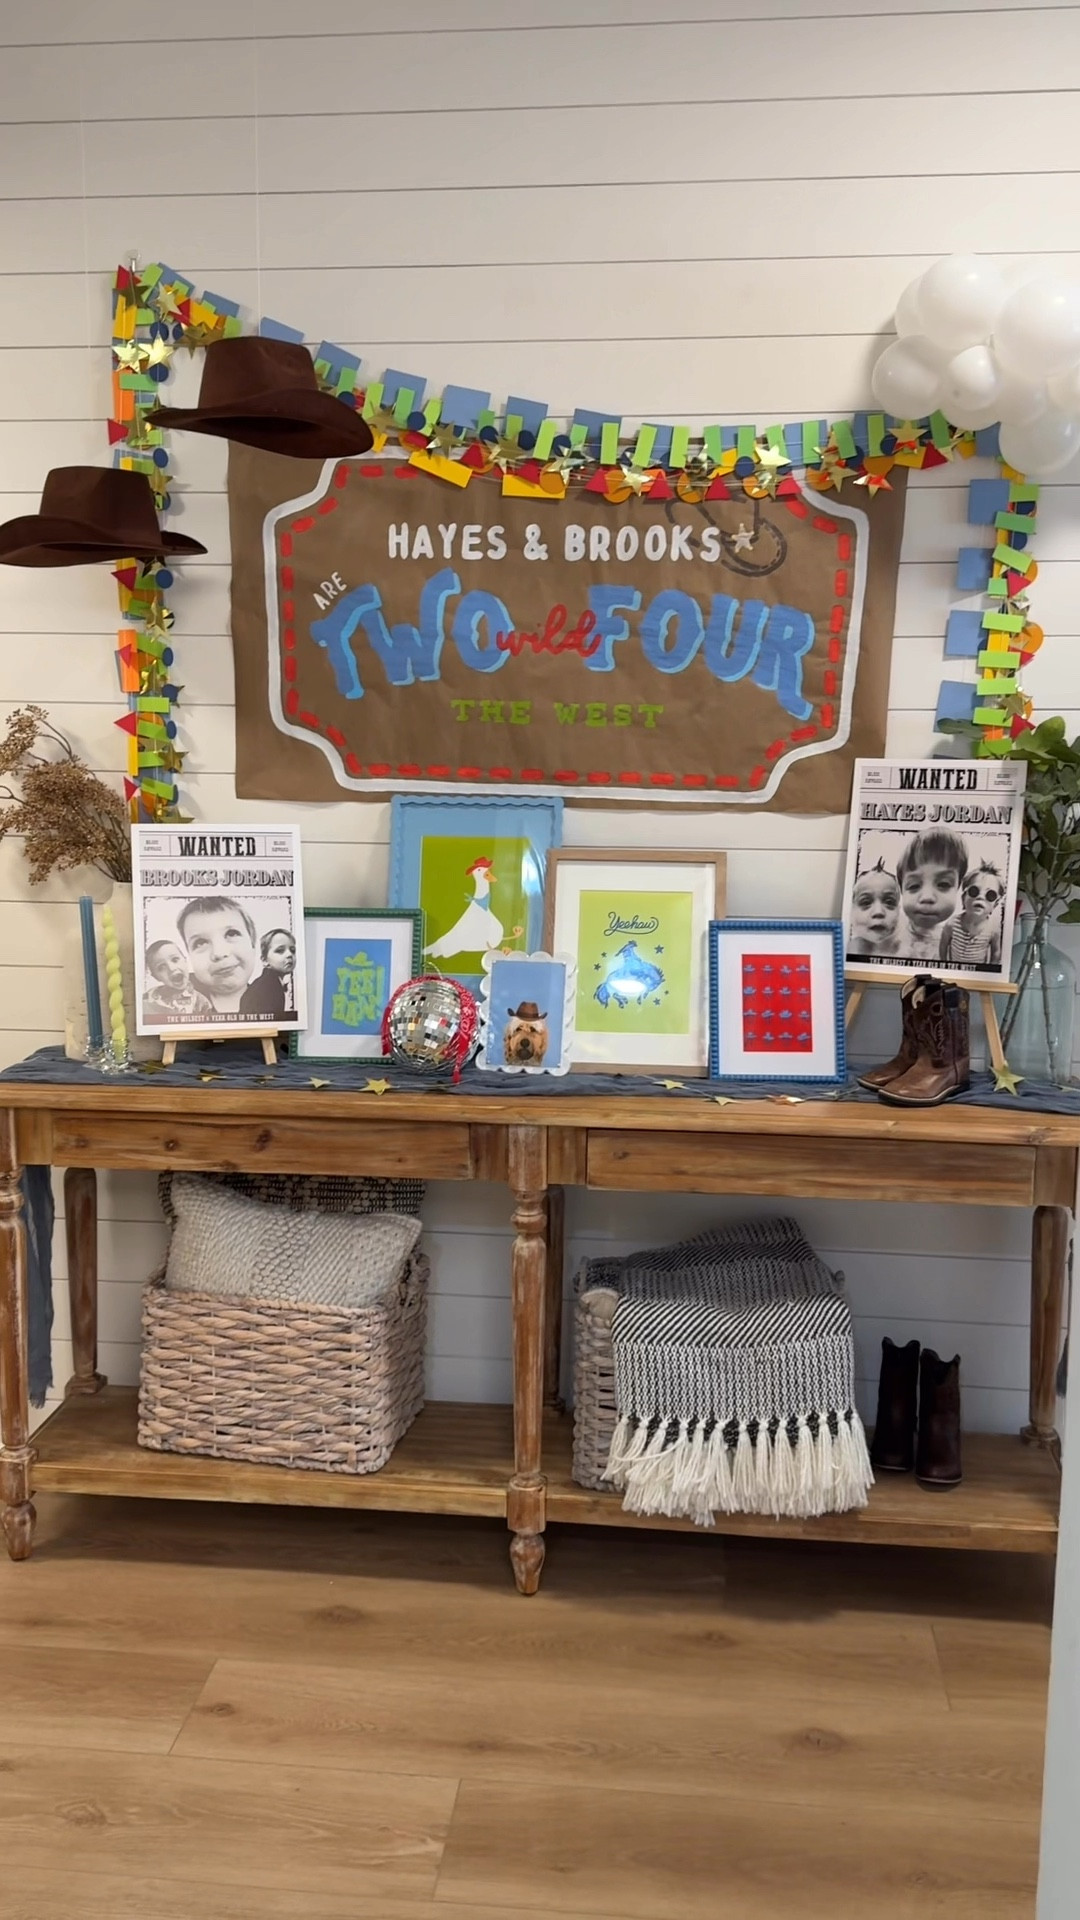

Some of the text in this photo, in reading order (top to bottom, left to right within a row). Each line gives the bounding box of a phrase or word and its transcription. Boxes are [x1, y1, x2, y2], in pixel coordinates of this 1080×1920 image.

[388, 523, 721, 563] HAYES & BROOKS
[312, 571, 348, 610] ARE
[309, 566, 815, 721] TWO wild FOUR
[450, 699, 664, 727] THE WEST
[898, 768, 978, 790] WANTED
[860, 803, 1013, 825] HAYES JORDAN
[178, 836, 257, 857] WANTED
[140, 869, 295, 887] BROOKS JORDAN
[603, 911, 659, 936] Yeehaw
[912, 960, 927, 968] YEAR
